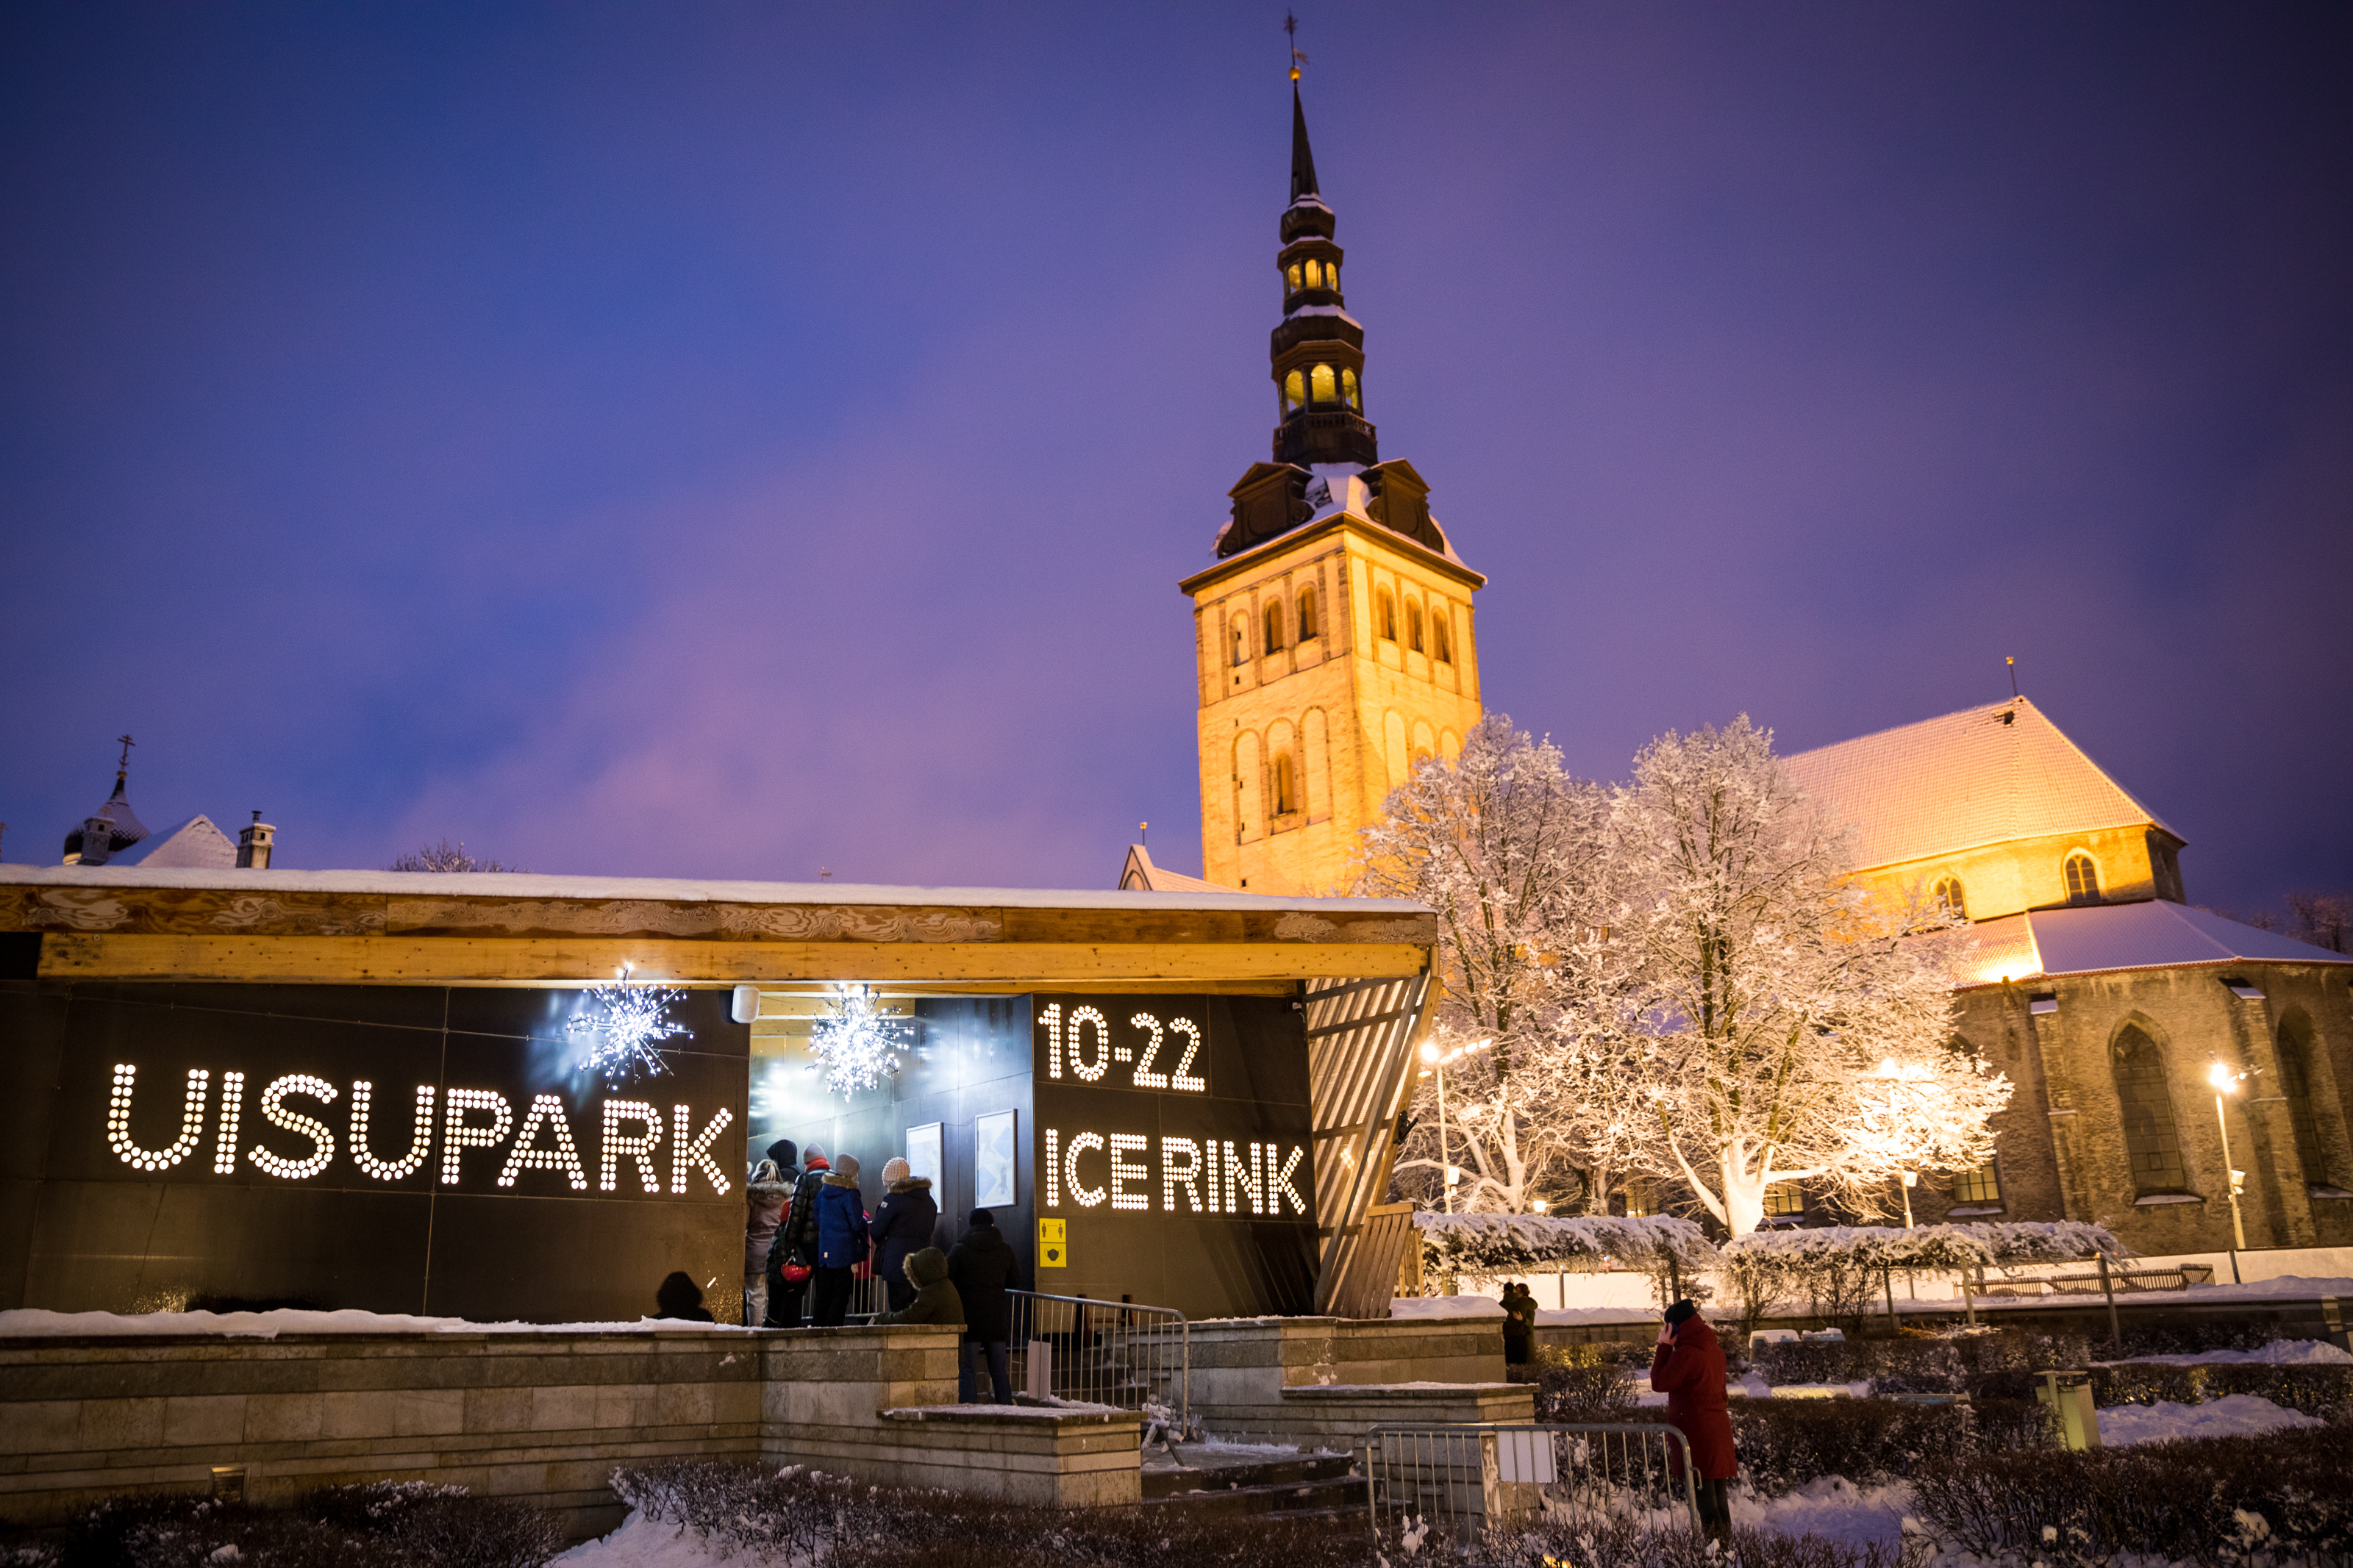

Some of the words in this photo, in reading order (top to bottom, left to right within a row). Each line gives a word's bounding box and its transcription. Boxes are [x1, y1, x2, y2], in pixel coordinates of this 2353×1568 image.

[1038, 1003, 1205, 1092] 10-22
[107, 1064, 733, 1196] UISUPARK
[1046, 1128, 1149, 1210] ICE
[1162, 1136, 1306, 1214] RINK
